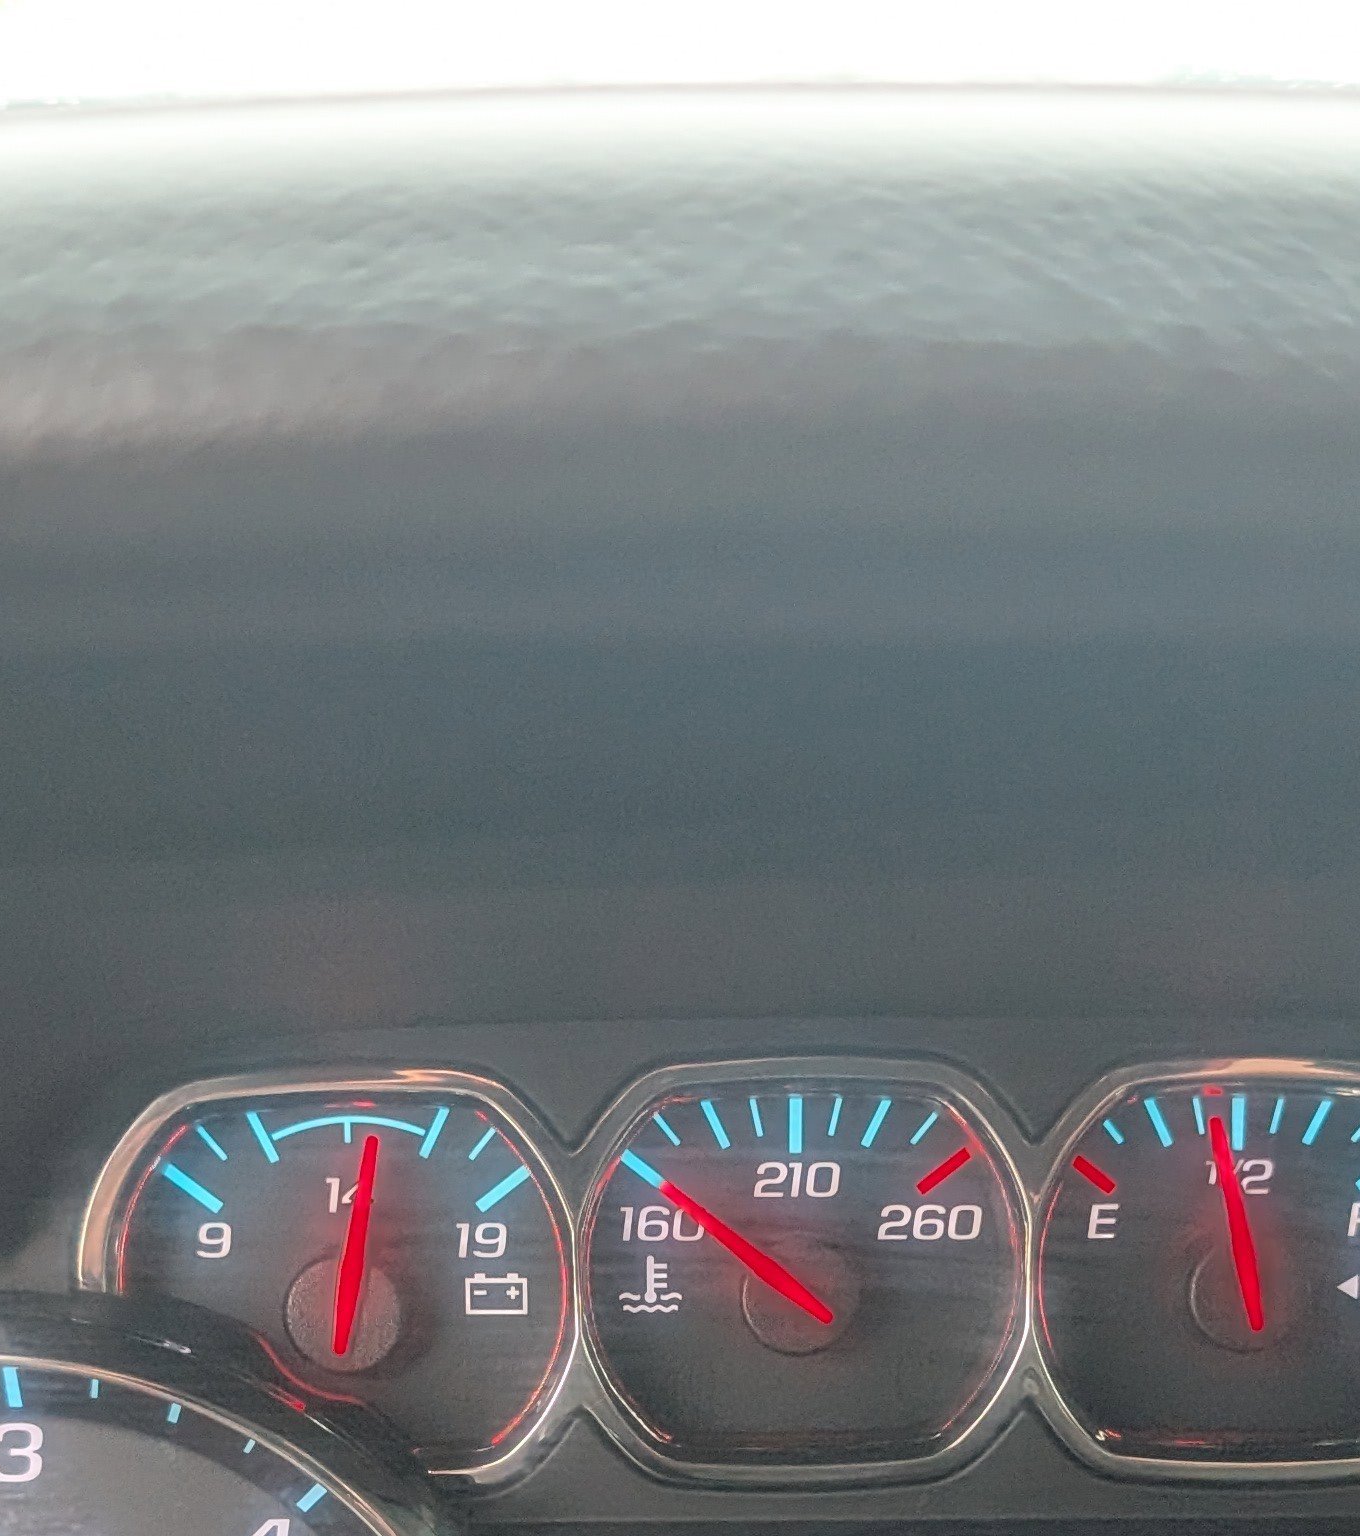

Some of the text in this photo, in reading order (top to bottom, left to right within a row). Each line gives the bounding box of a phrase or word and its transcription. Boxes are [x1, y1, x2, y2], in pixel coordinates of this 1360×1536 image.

[754, 1162, 840, 1198] 210
[620, 1205, 705, 1242] 160
[877, 1203, 983, 1241] 260
[1087, 1203, 1120, 1239] E
[198, 1222, 232, 1259] 9
[456, 1222, 507, 1259] 19
